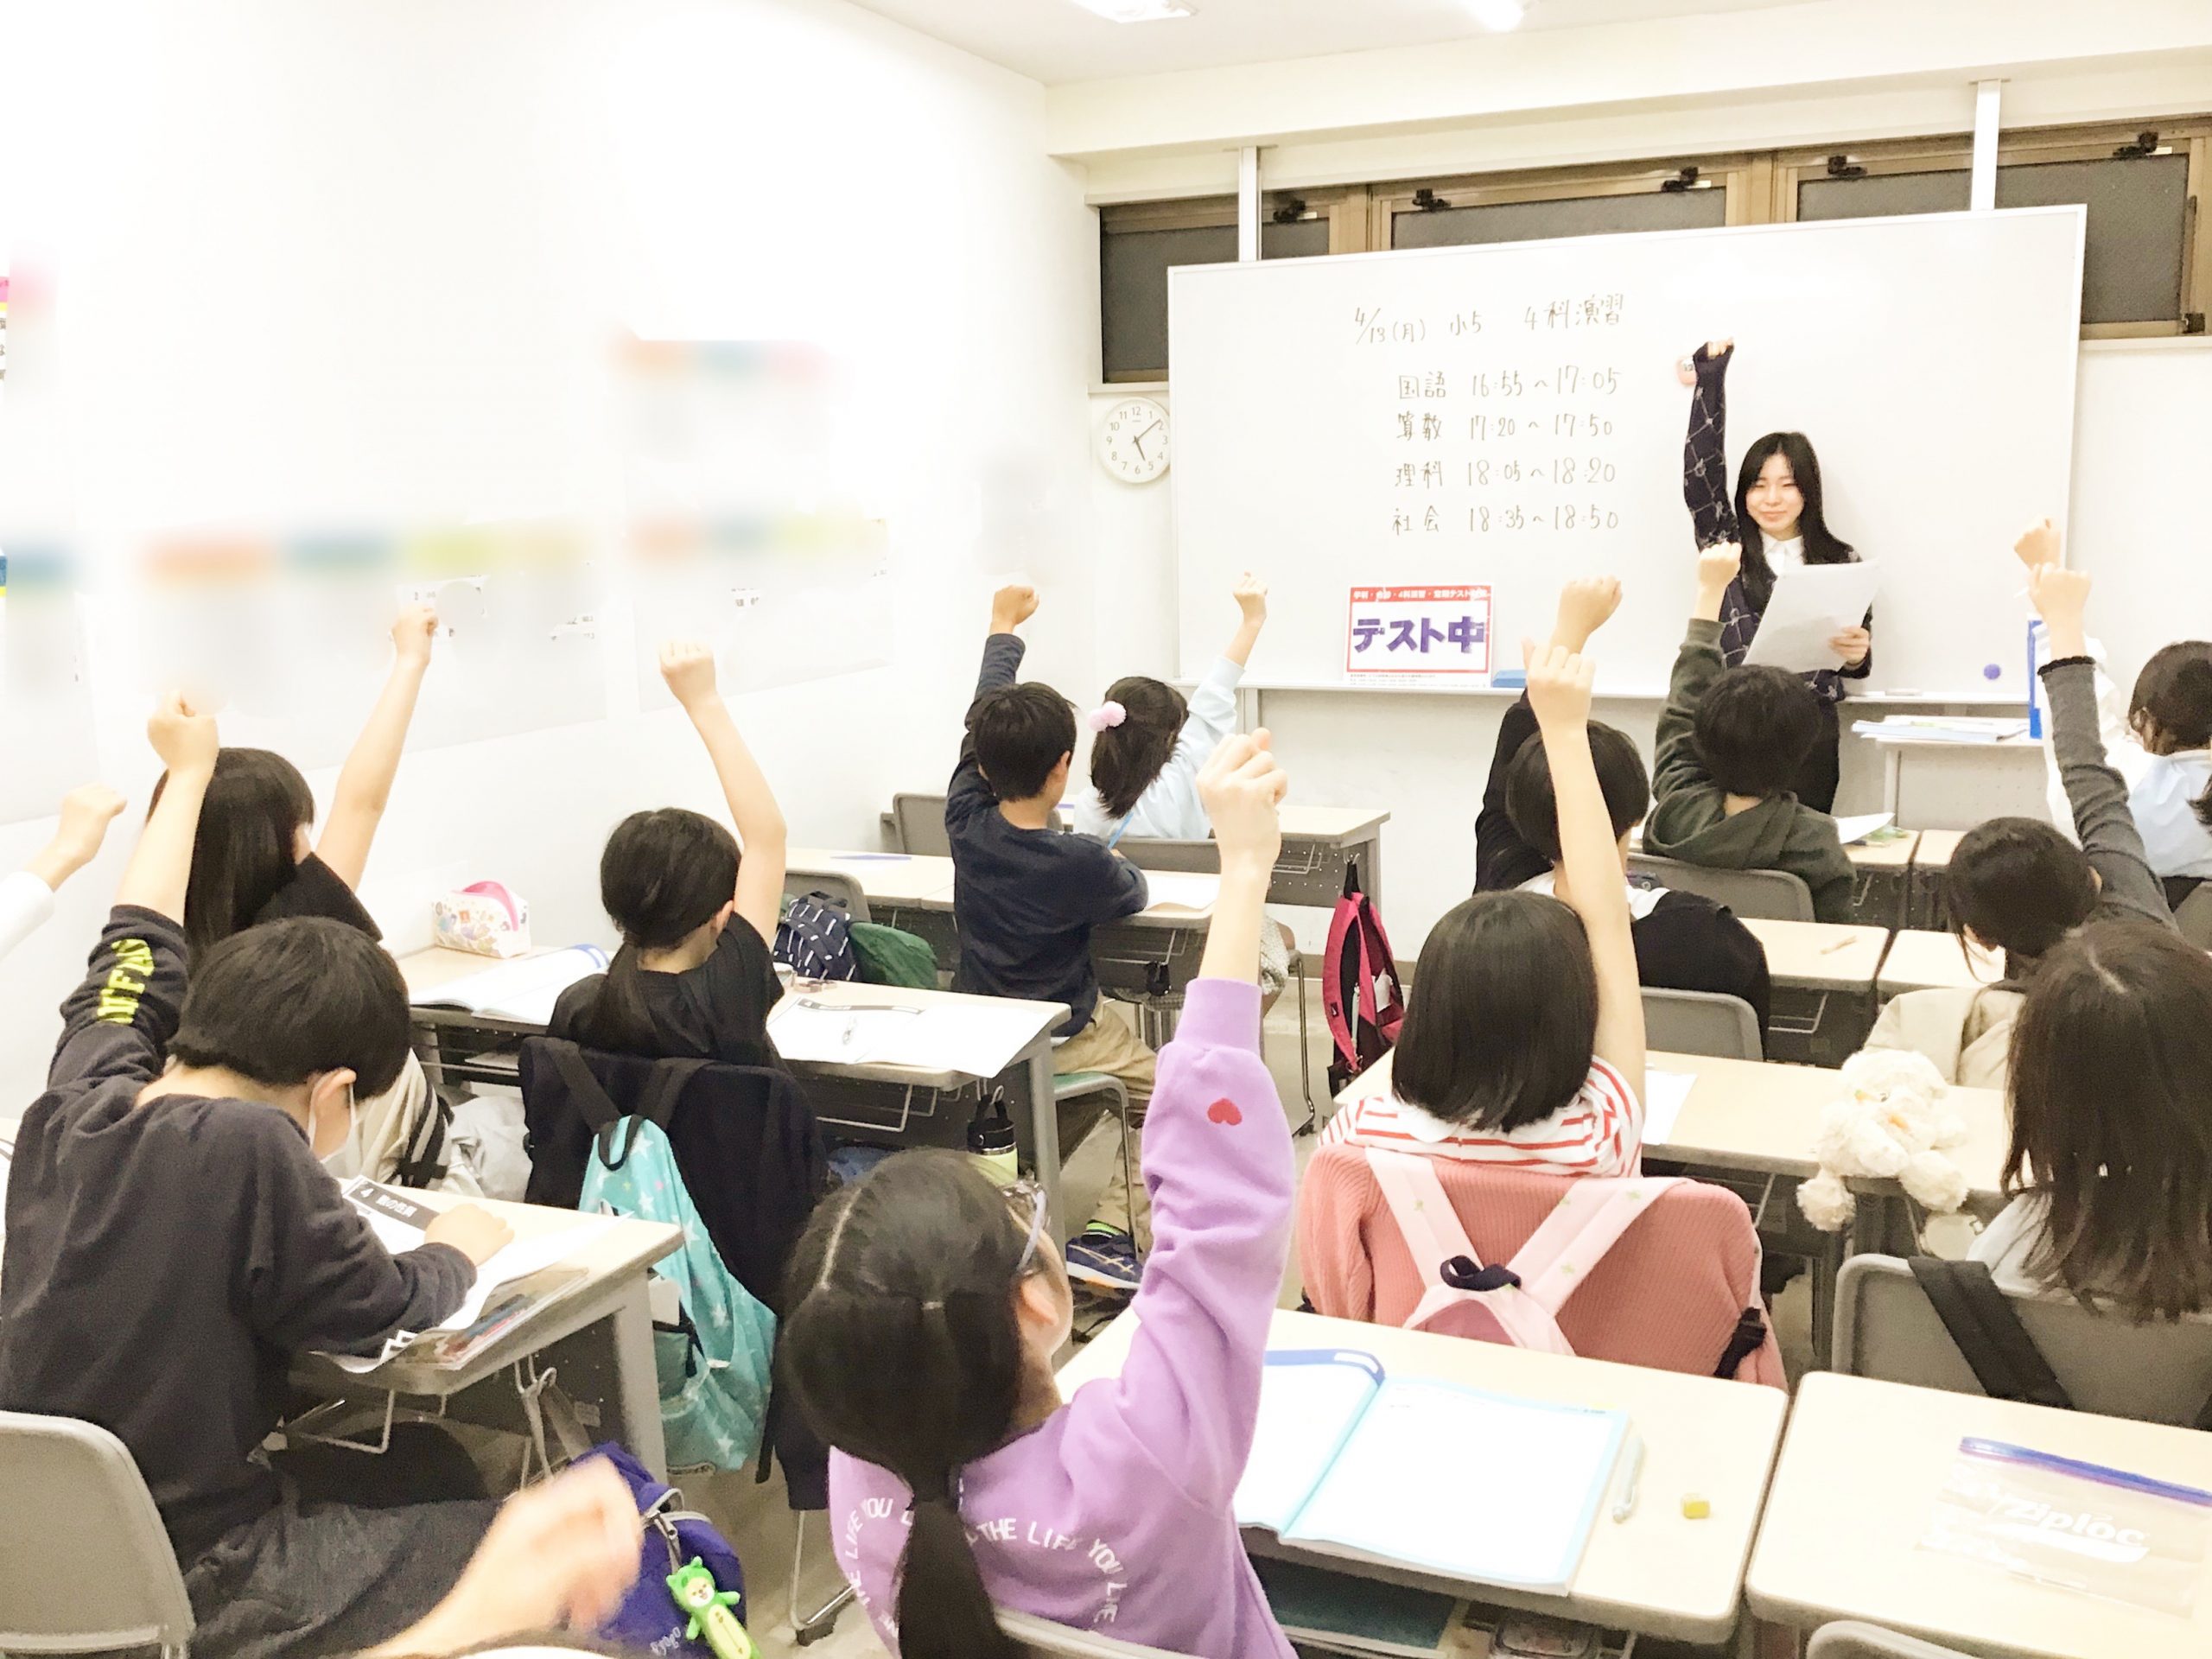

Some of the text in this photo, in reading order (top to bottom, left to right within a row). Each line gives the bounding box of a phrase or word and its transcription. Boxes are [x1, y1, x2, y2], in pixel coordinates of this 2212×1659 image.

[1450, 310, 1482, 337] 小5
[1398, 371, 1447, 400] 国語
[1109, 422, 1120, 431] 10
[1162, 435, 1168, 445] 3
[1396, 410, 1442, 442] 算数
[1106, 436, 1112, 445] 9
[1111, 451, 1117, 461] 8
[1135, 465, 1141, 474] 6
[1395, 461, 1443, 490] 理科
[1392, 505, 1440, 537] 社会
[1352, 615, 1485, 654] テスト中
[976, 1517, 1018, 1541] THE
[1088, 1538, 1125, 1574] YOU
